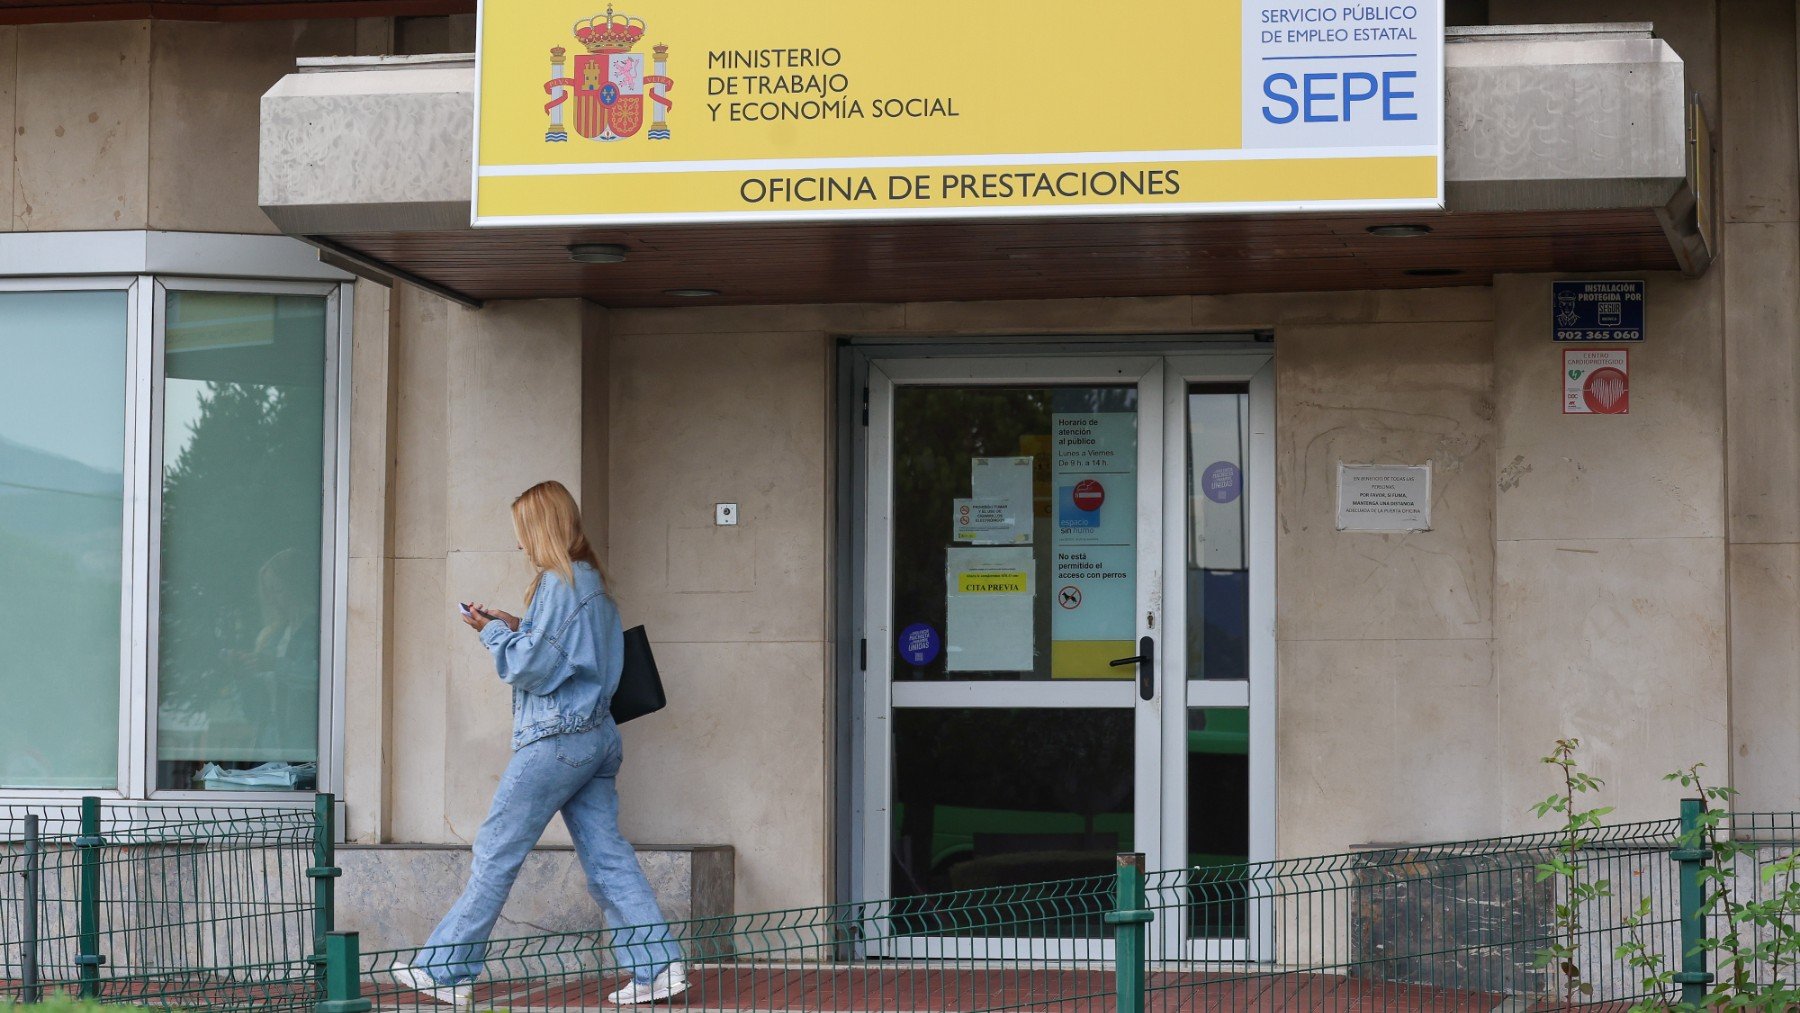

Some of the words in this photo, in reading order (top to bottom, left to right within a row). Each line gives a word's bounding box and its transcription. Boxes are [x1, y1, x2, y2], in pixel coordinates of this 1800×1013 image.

[1261, 7, 1338, 24] SERVICIO
[1342, 3, 1417, 21] PÚBLICO
[1261, 30, 1283, 43] DE
[1287, 28, 1349, 43] EMPLEO
[1354, 27, 1418, 41] ESTATAL
[708, 47, 842, 69] MINISTERIO
[708, 76, 739, 95] DE
[742, 74, 849, 97] TRABAJO
[1261, 70, 1418, 125] SEPE
[707, 105, 718, 122] Y
[729, 95, 865, 121] ECONOMÍA
[872, 98, 960, 118] SOCIAL
[740, 175, 878, 204] OFICINA
[887, 175, 931, 200] DE
[942, 169, 1181, 200] PRESTACIONES
[1584, 283, 1636, 293] INSTALACIÓN
[1578, 293, 1621, 301] PROTEGIDA
[1557, 331, 1582, 340] 902
[1586, 331, 1610, 340] 365
[1613, 331, 1639, 340] 060
[1058, 428, 1092, 436] atención
[1067, 438, 1096, 447] público
[1088, 449, 1115, 457] Viernes
[1092, 459, 1101, 467] 14
[1060, 520, 1089, 528] espacio
[1060, 526, 1072, 534] sin
[1072, 526, 1095, 534] humo
[1070, 552, 1087, 560] está
[1058, 562, 1094, 570] permitido
[1058, 571, 1085, 579] acceso
[988, 583, 1019, 591] PREVIA
